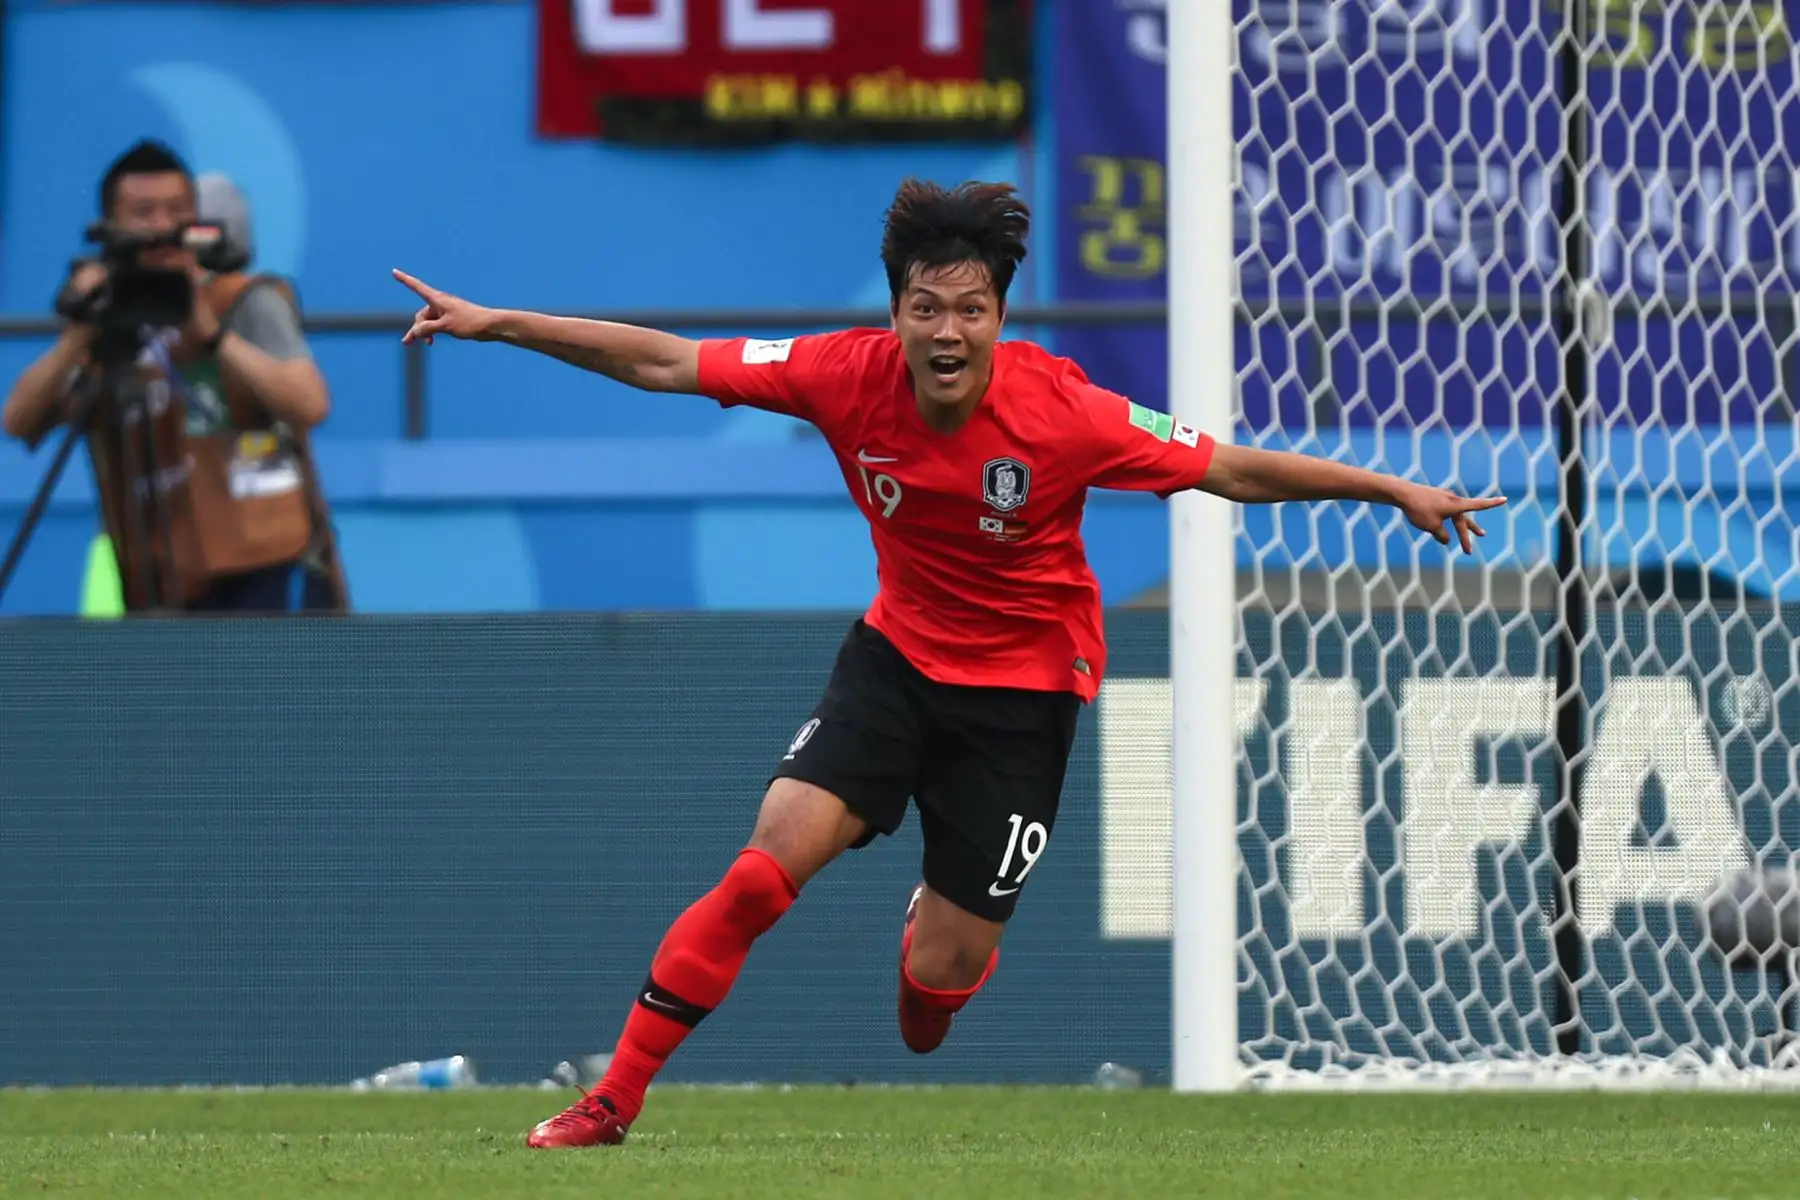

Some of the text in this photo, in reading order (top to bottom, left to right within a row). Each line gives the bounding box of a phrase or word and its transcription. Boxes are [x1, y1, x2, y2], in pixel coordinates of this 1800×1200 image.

[856, 463, 903, 519] 19
[1100, 677, 1751, 938] FIFA
[997, 812, 1048, 884] 19
